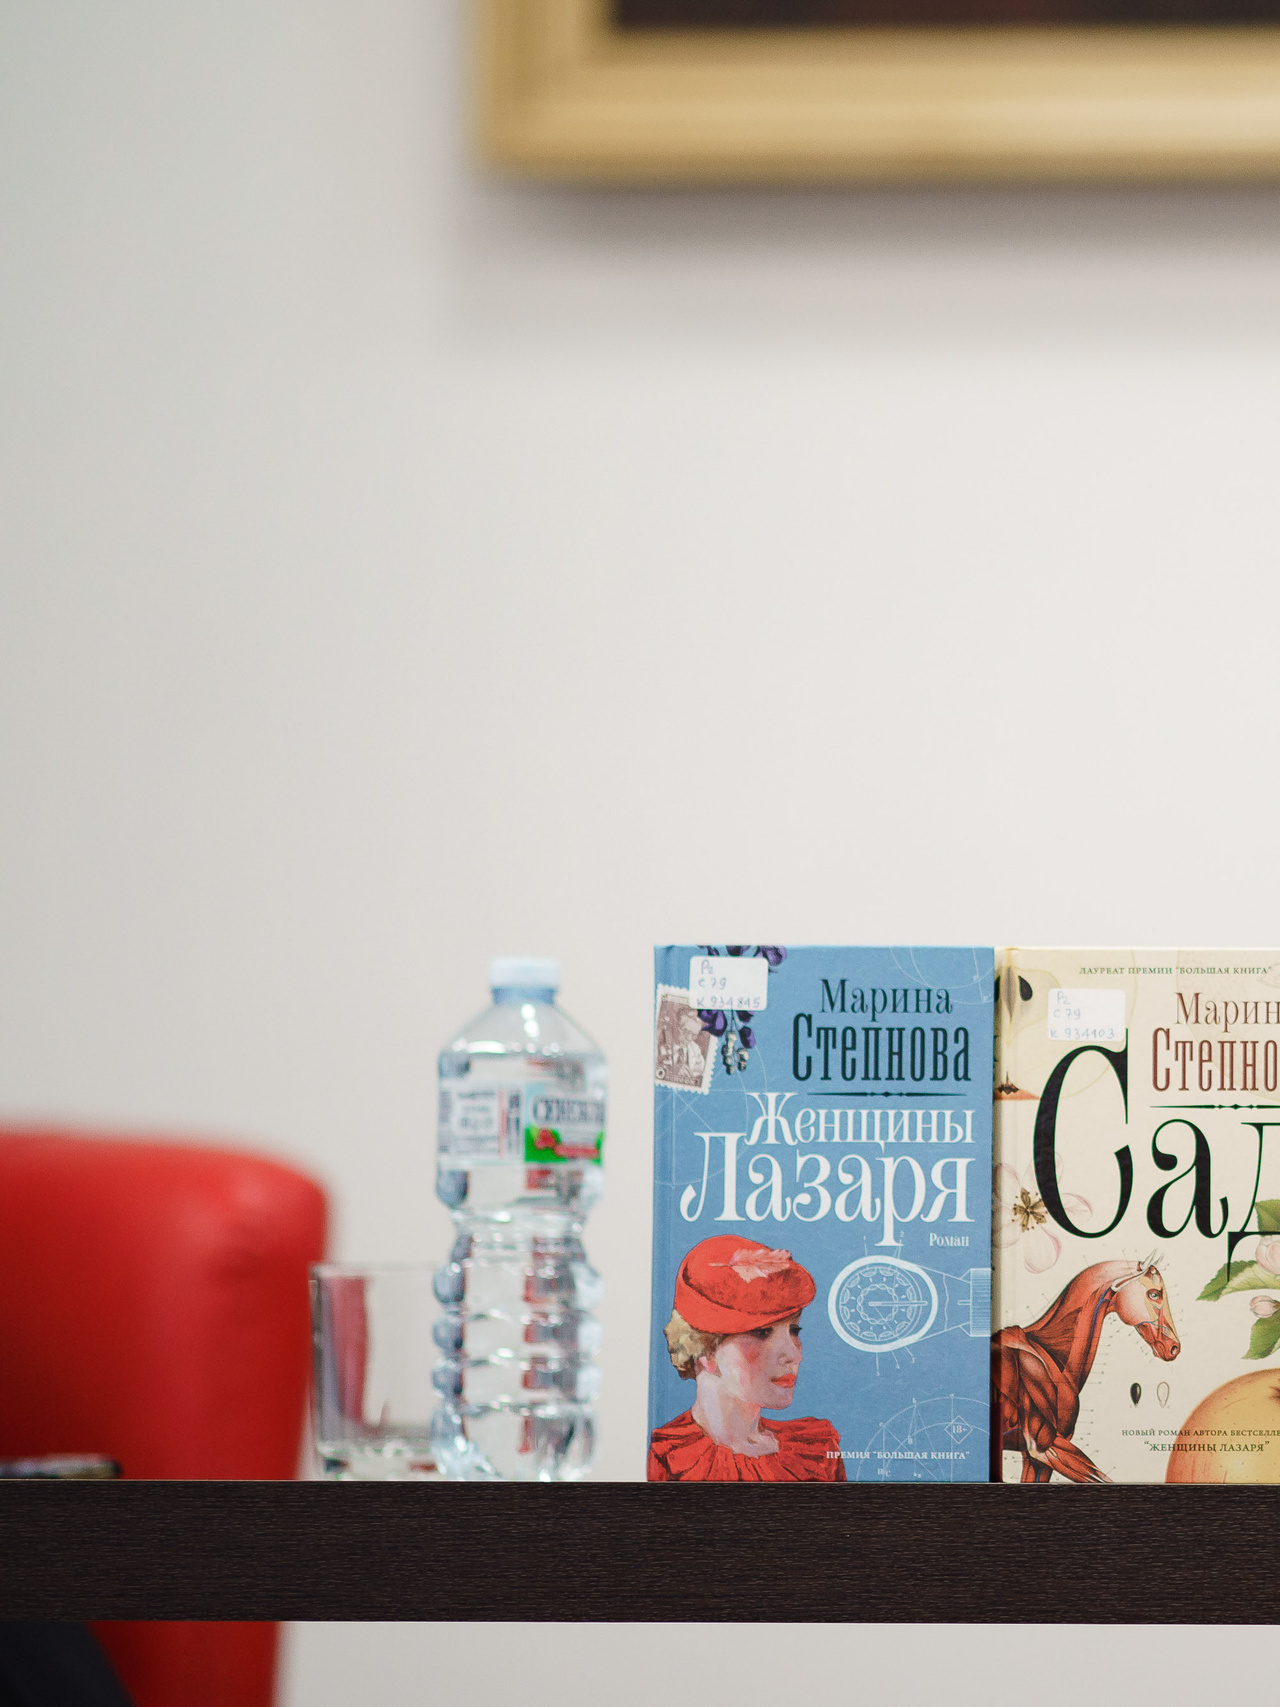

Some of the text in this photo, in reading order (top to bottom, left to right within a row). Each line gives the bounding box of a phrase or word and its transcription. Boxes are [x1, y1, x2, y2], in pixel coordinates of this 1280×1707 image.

[1079, 967, 1125, 975] ЛАУРЕАТ
[1128, 967, 1173, 975] ПРЕМИИ
[819, 978, 953, 1022] Марина
[792, 1013, 971, 1082] Степнова
[744, 1092, 976, 1154] Женщины
[679, 1132, 976, 1247] Лазаря
[928, 1232, 970, 1247] Роман
[951, 1424, 967, 1434] 18+
[1121, 1428, 1156, 1437] НОВЫЙ
[1158, 1429, 1191, 1437] РОМАН
[1193, 1429, 1228, 1437] АВТОРА
[826, 1451, 870, 1460] ПРЕМИЯ
